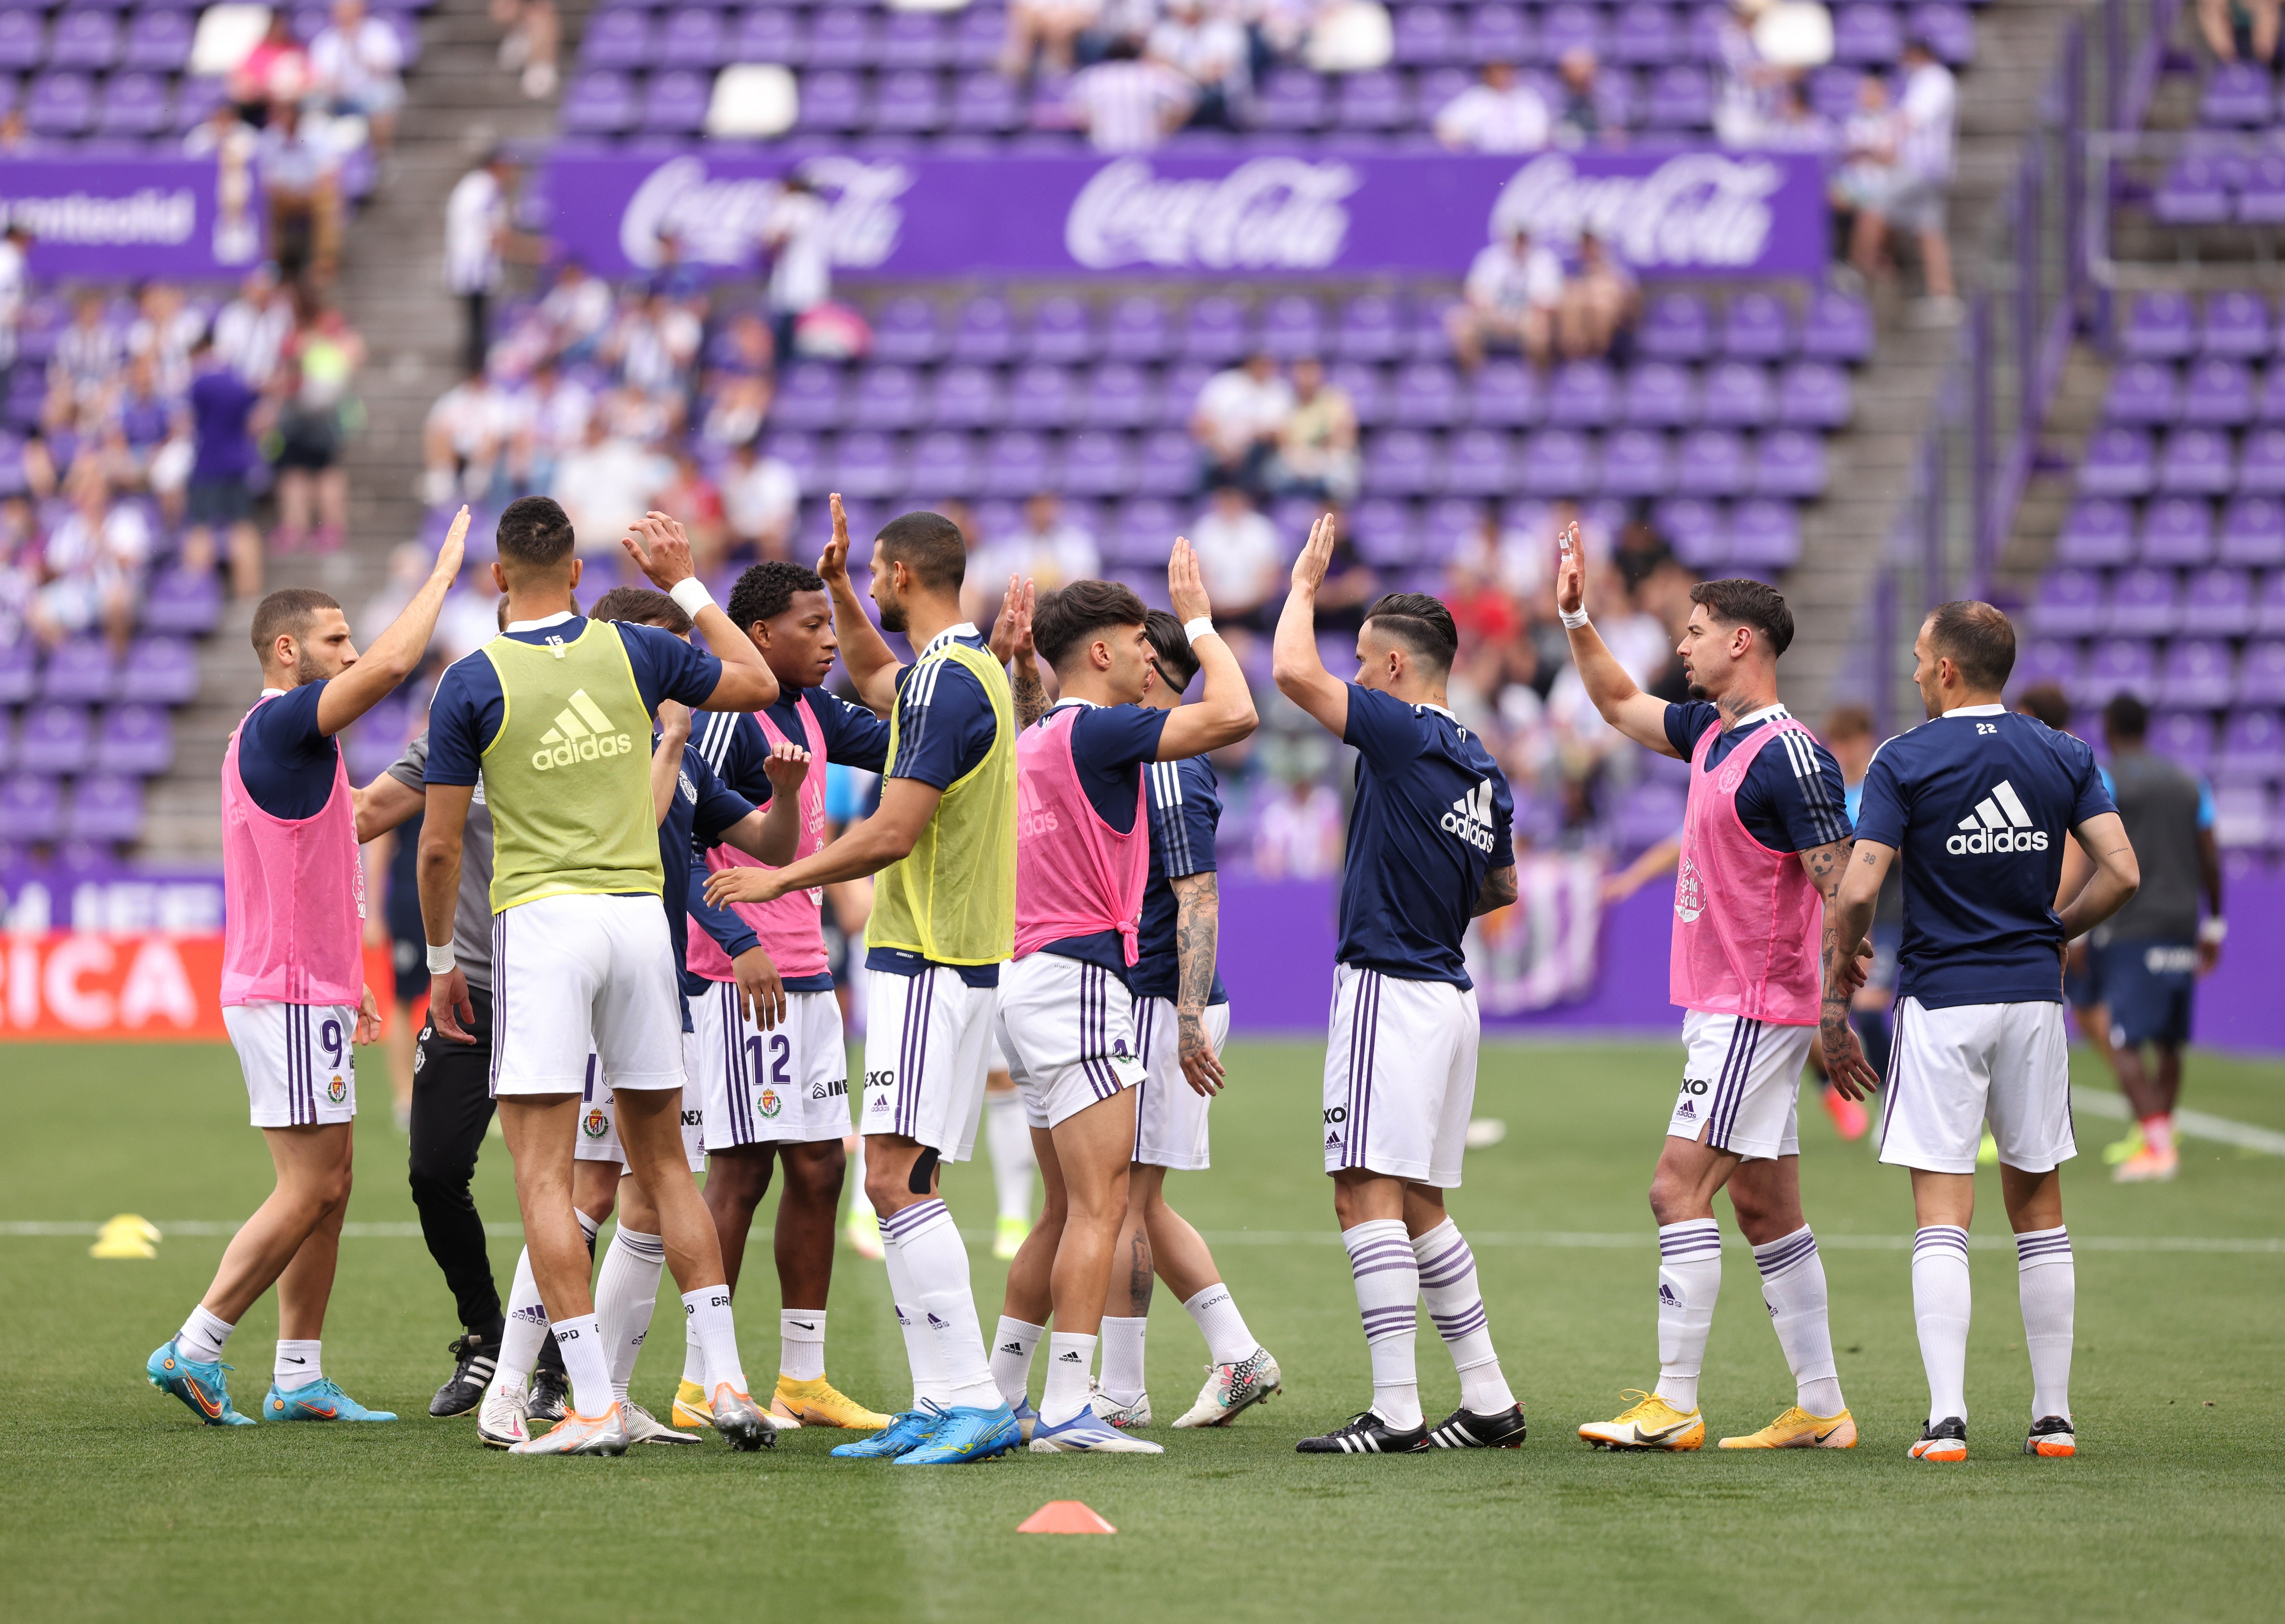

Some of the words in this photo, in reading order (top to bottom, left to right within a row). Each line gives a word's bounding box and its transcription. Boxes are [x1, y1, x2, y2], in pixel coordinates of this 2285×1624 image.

[622, 157, 916, 267] Cocaola
[545, 635, 564, 646] 15
[1457, 727, 1466, 743] 17
[1976, 723, 1998, 735] 22
[532, 734, 632, 770] adidas
[1441, 812, 1494, 853] adidas
[1946, 827, 2048, 854] adidas
[1863, 852, 1876, 865] 38
[320, 1019, 343, 1070] 9
[744, 1034, 791, 1085] 12
[871, 1104, 890, 1112] adidas
[1676, 1110, 1697, 1119] adidas
[681, 1110, 704, 1126] NEX
[1325, 1141, 1344, 1150] adidas
[511, 1311, 549, 1327] adidas
[1000, 1347, 1023, 1356] adidas
